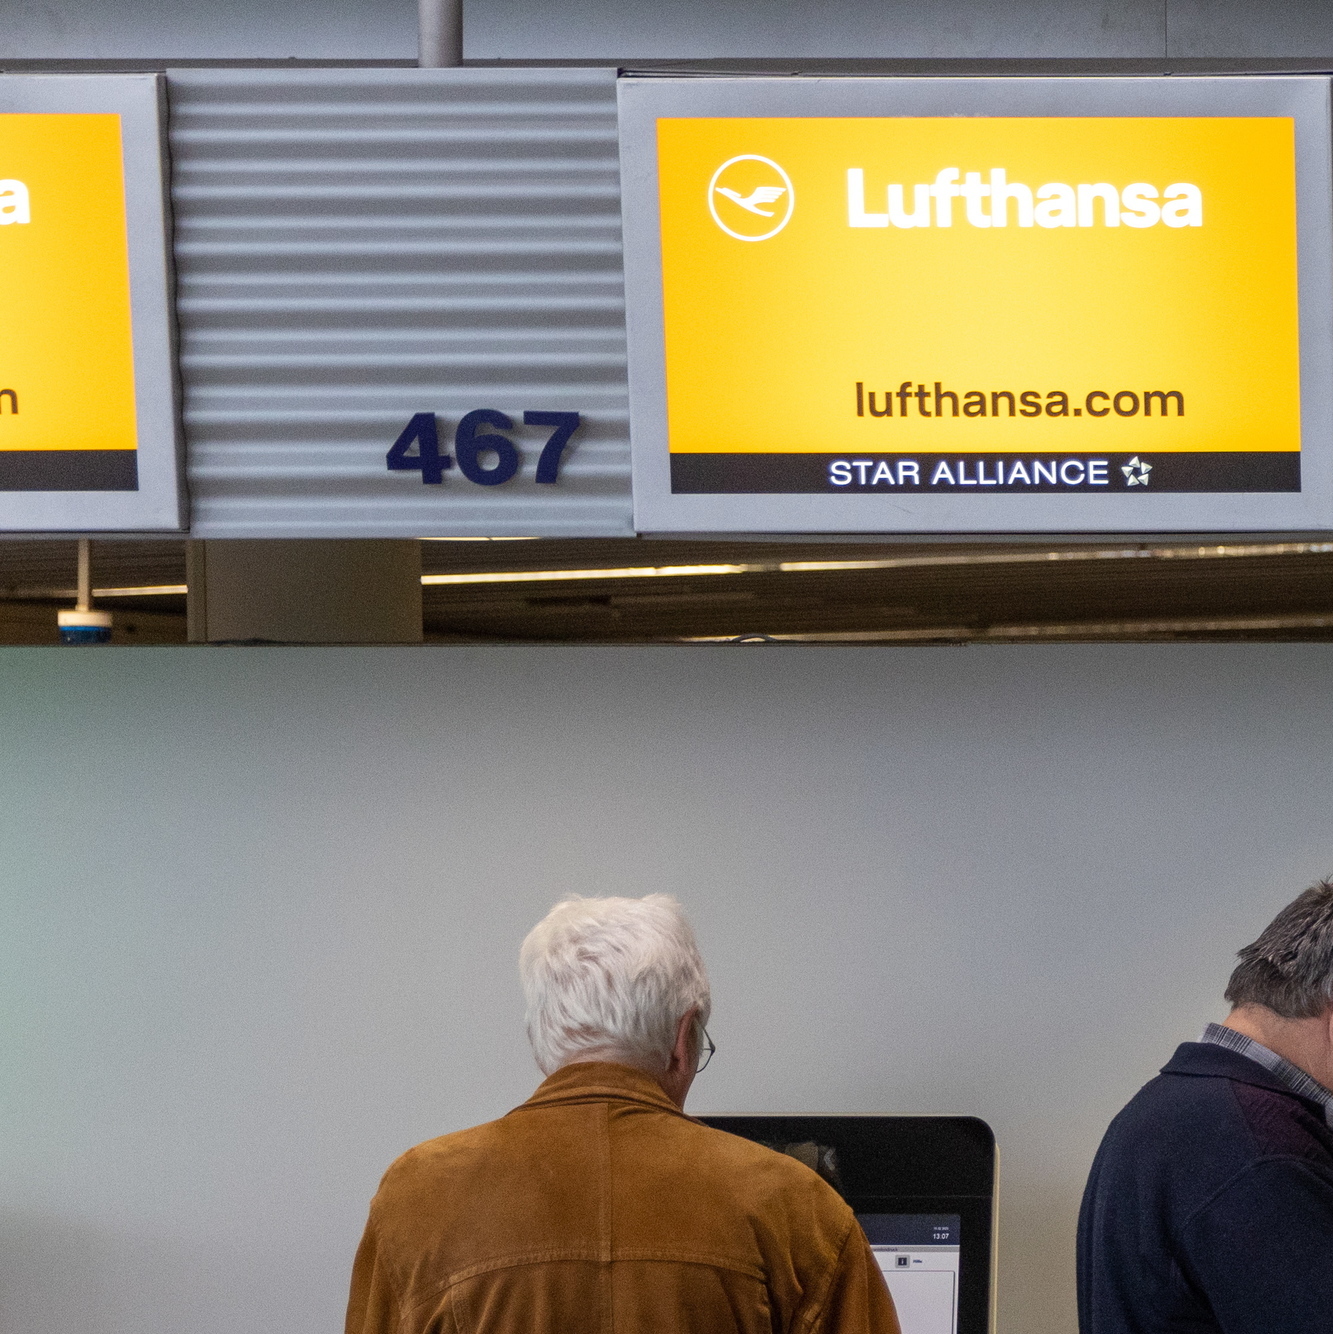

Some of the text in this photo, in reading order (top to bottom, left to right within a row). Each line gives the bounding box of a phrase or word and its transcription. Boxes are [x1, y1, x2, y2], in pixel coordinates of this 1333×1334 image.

[847, 167, 1203, 229] Lufthansa
[856, 381, 1185, 417] lufthansa.com
[385, 408, 581, 486] 467
[828, 458, 1110, 487] STAR ALLIANCE
